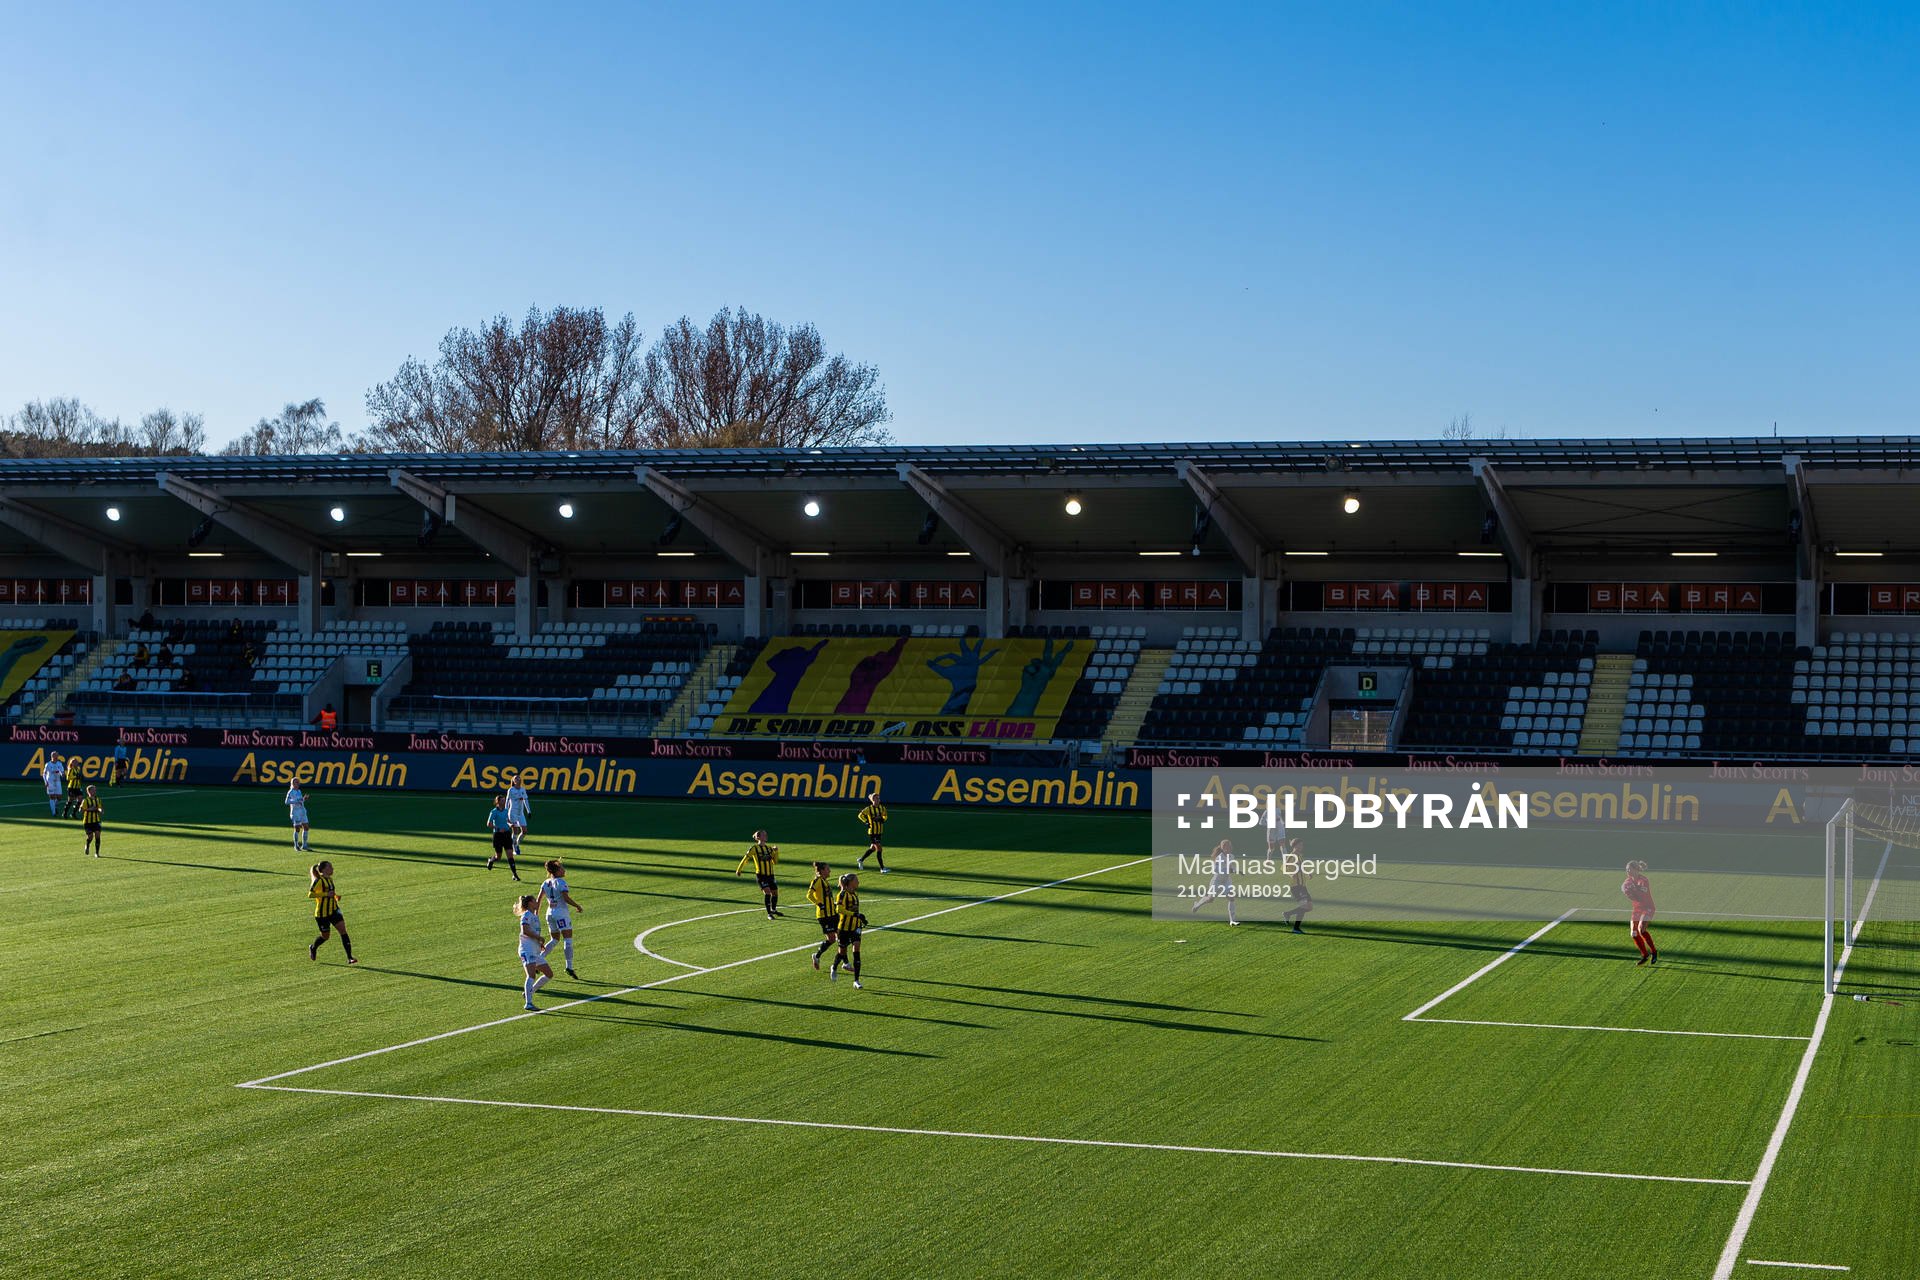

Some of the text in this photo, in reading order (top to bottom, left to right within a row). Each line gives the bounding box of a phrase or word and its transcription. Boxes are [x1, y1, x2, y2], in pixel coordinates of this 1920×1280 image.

[61, 585, 88, 596] BR
[257, 586, 298, 597] BR
[396, 586, 448, 597] BRA
[612, 587, 741, 598] BRA BRA
[839, 587, 976, 598] BRA BRA
[1080, 588, 1222, 599] BRA BRA
[1331, 588, 1483, 600] BRA BRA
[1597, 590, 1756, 602] BRA BRA
[1878, 591, 1920, 603] BR
[370, 664, 378, 677] E
[1362, 677, 1373, 690] D
[21, 747, 188, 781] Aeblin
[232, 752, 407, 787] Assemblin
[451, 757, 637, 793] Assemblin
[687, 762, 882, 798] Assemblin
[932, 768, 1139, 806] Assemblin
